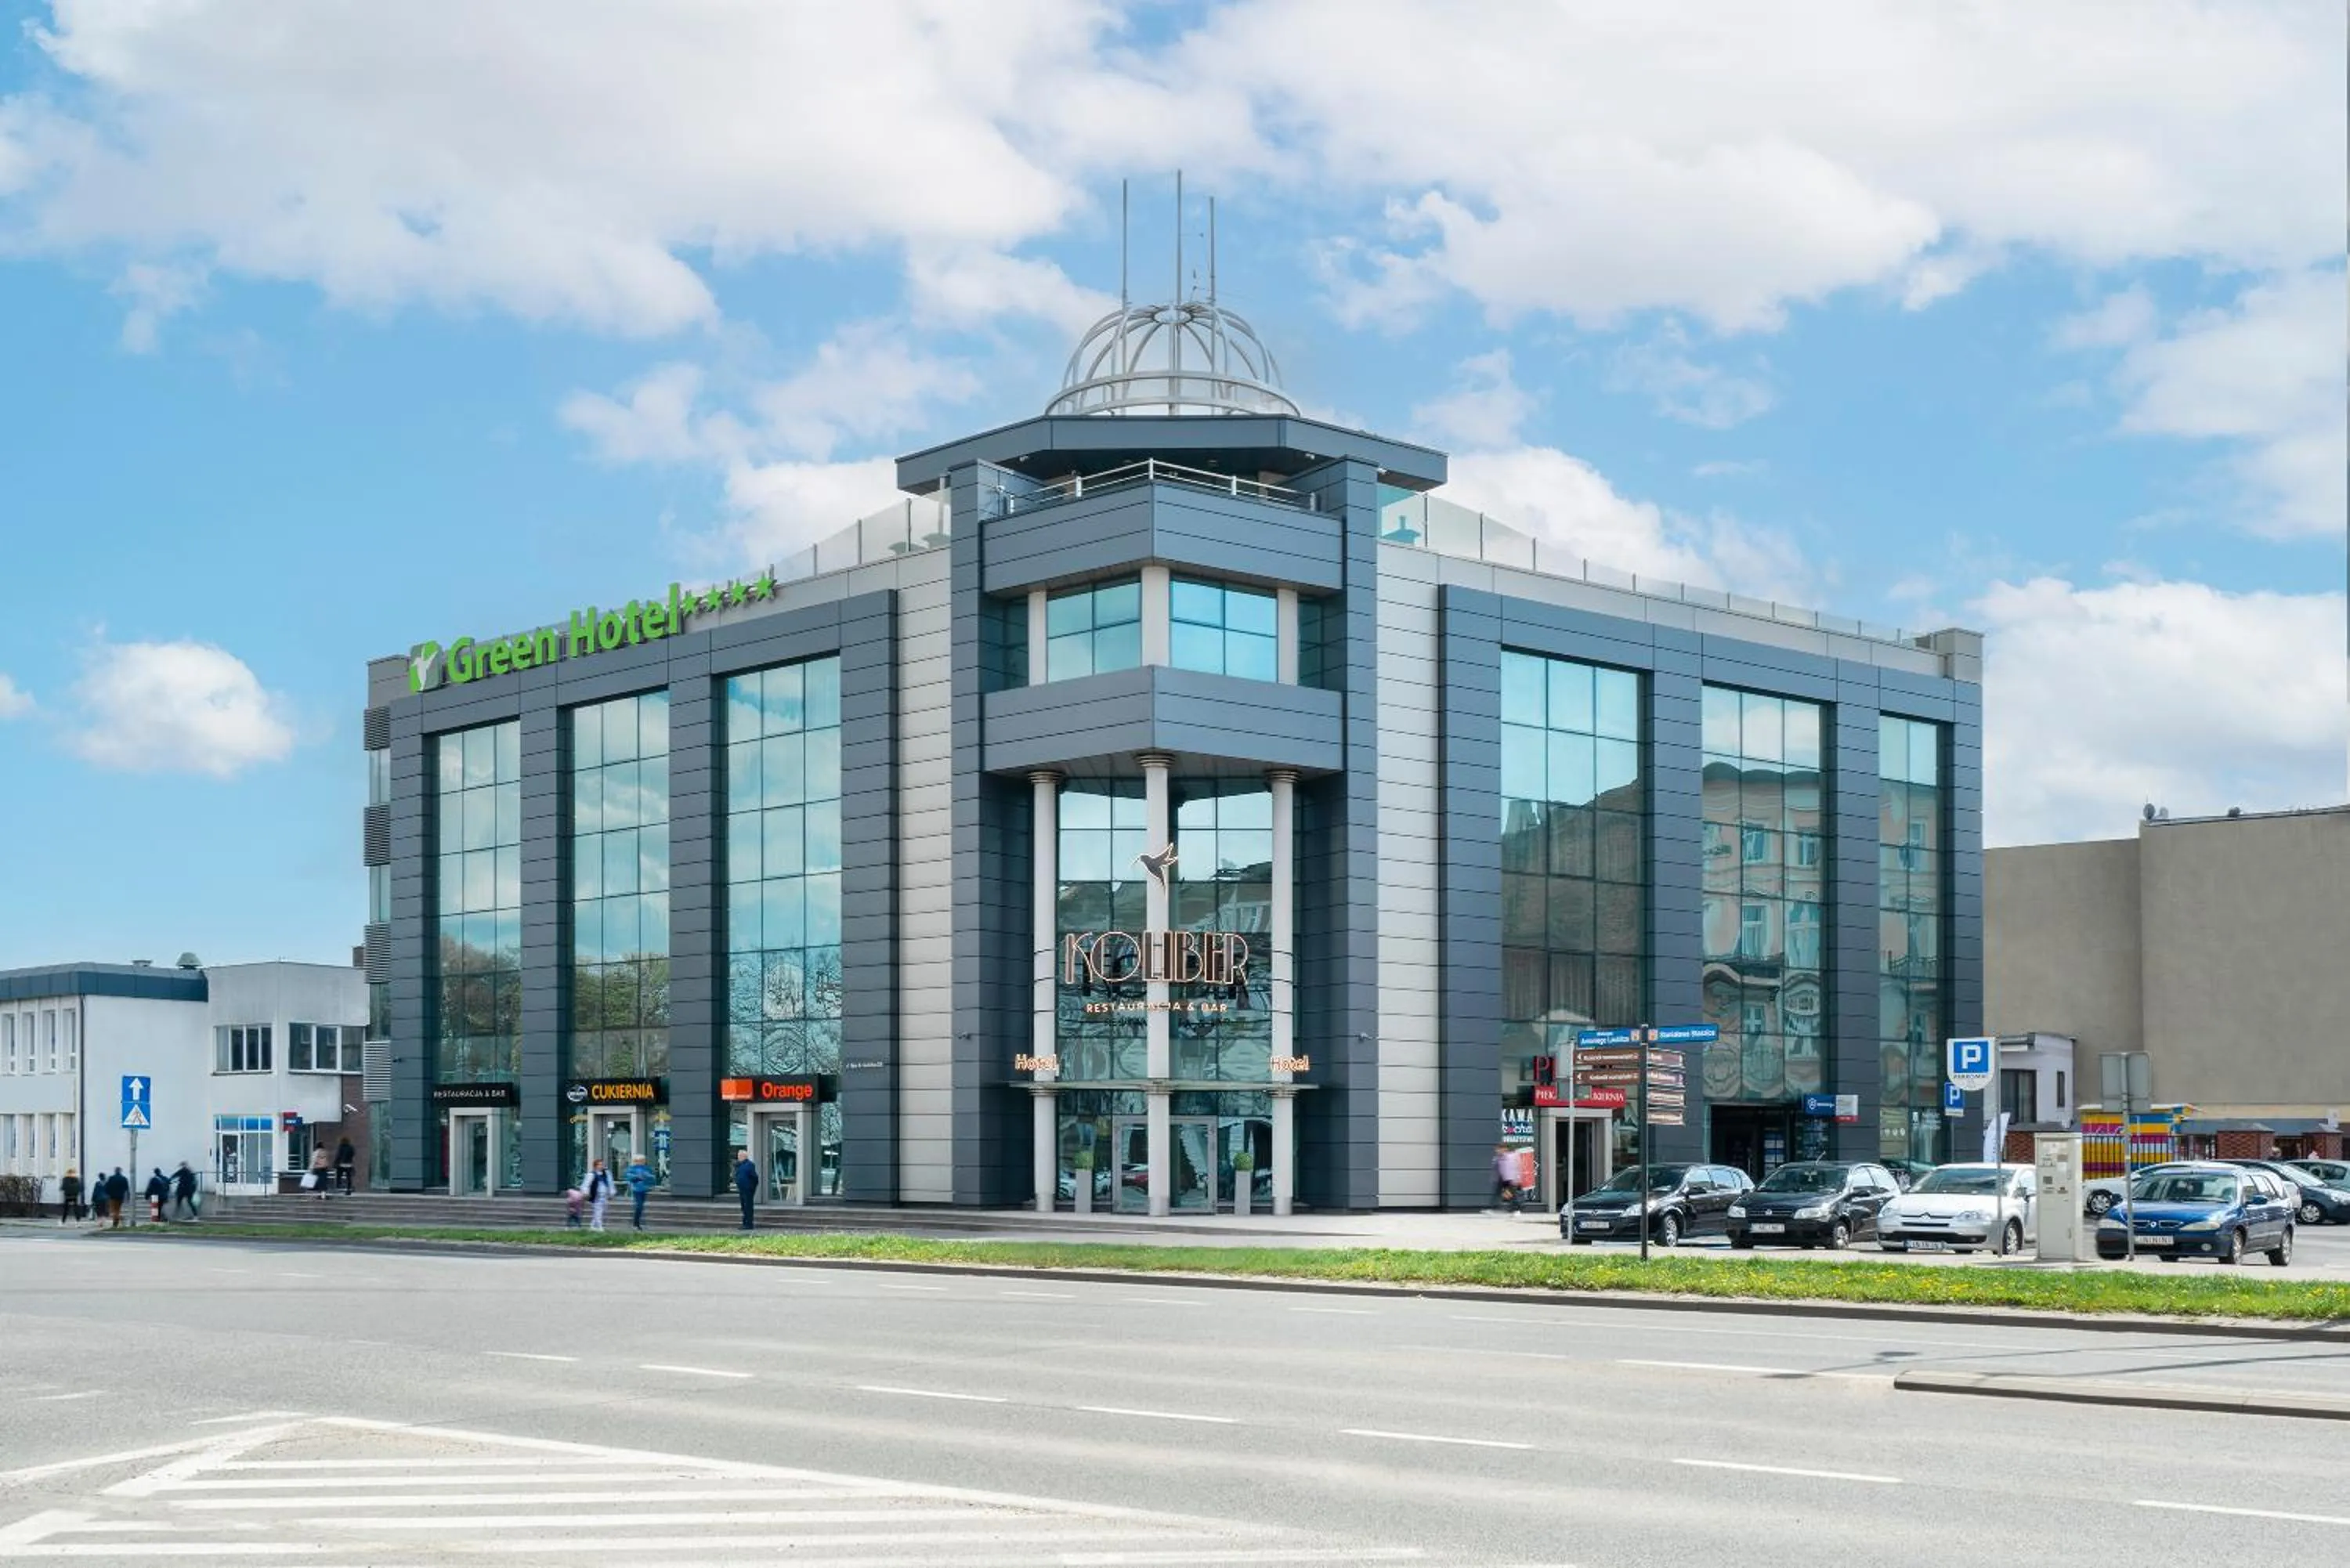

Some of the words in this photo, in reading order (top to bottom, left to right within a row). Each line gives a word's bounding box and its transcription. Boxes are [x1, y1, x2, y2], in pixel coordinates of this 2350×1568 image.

[446, 627, 558, 684] Green
[569, 583, 681, 657] Hotel
[1065, 930, 1249, 985] KOLIBER
[1086, 1002, 1181, 1013] RESTAURACJA
[1187, 1003, 1195, 1011] &
[1201, 1003, 1228, 1012] BAR
[1014, 1053, 1057, 1071] Hotel
[1270, 1054, 1309, 1072] Hotel
[1961, 1044, 1982, 1069] P
[591, 1082, 655, 1100] CUKIERNIA
[761, 1082, 813, 1100] Orange
[1502, 1108, 1535, 1122] KAWA
